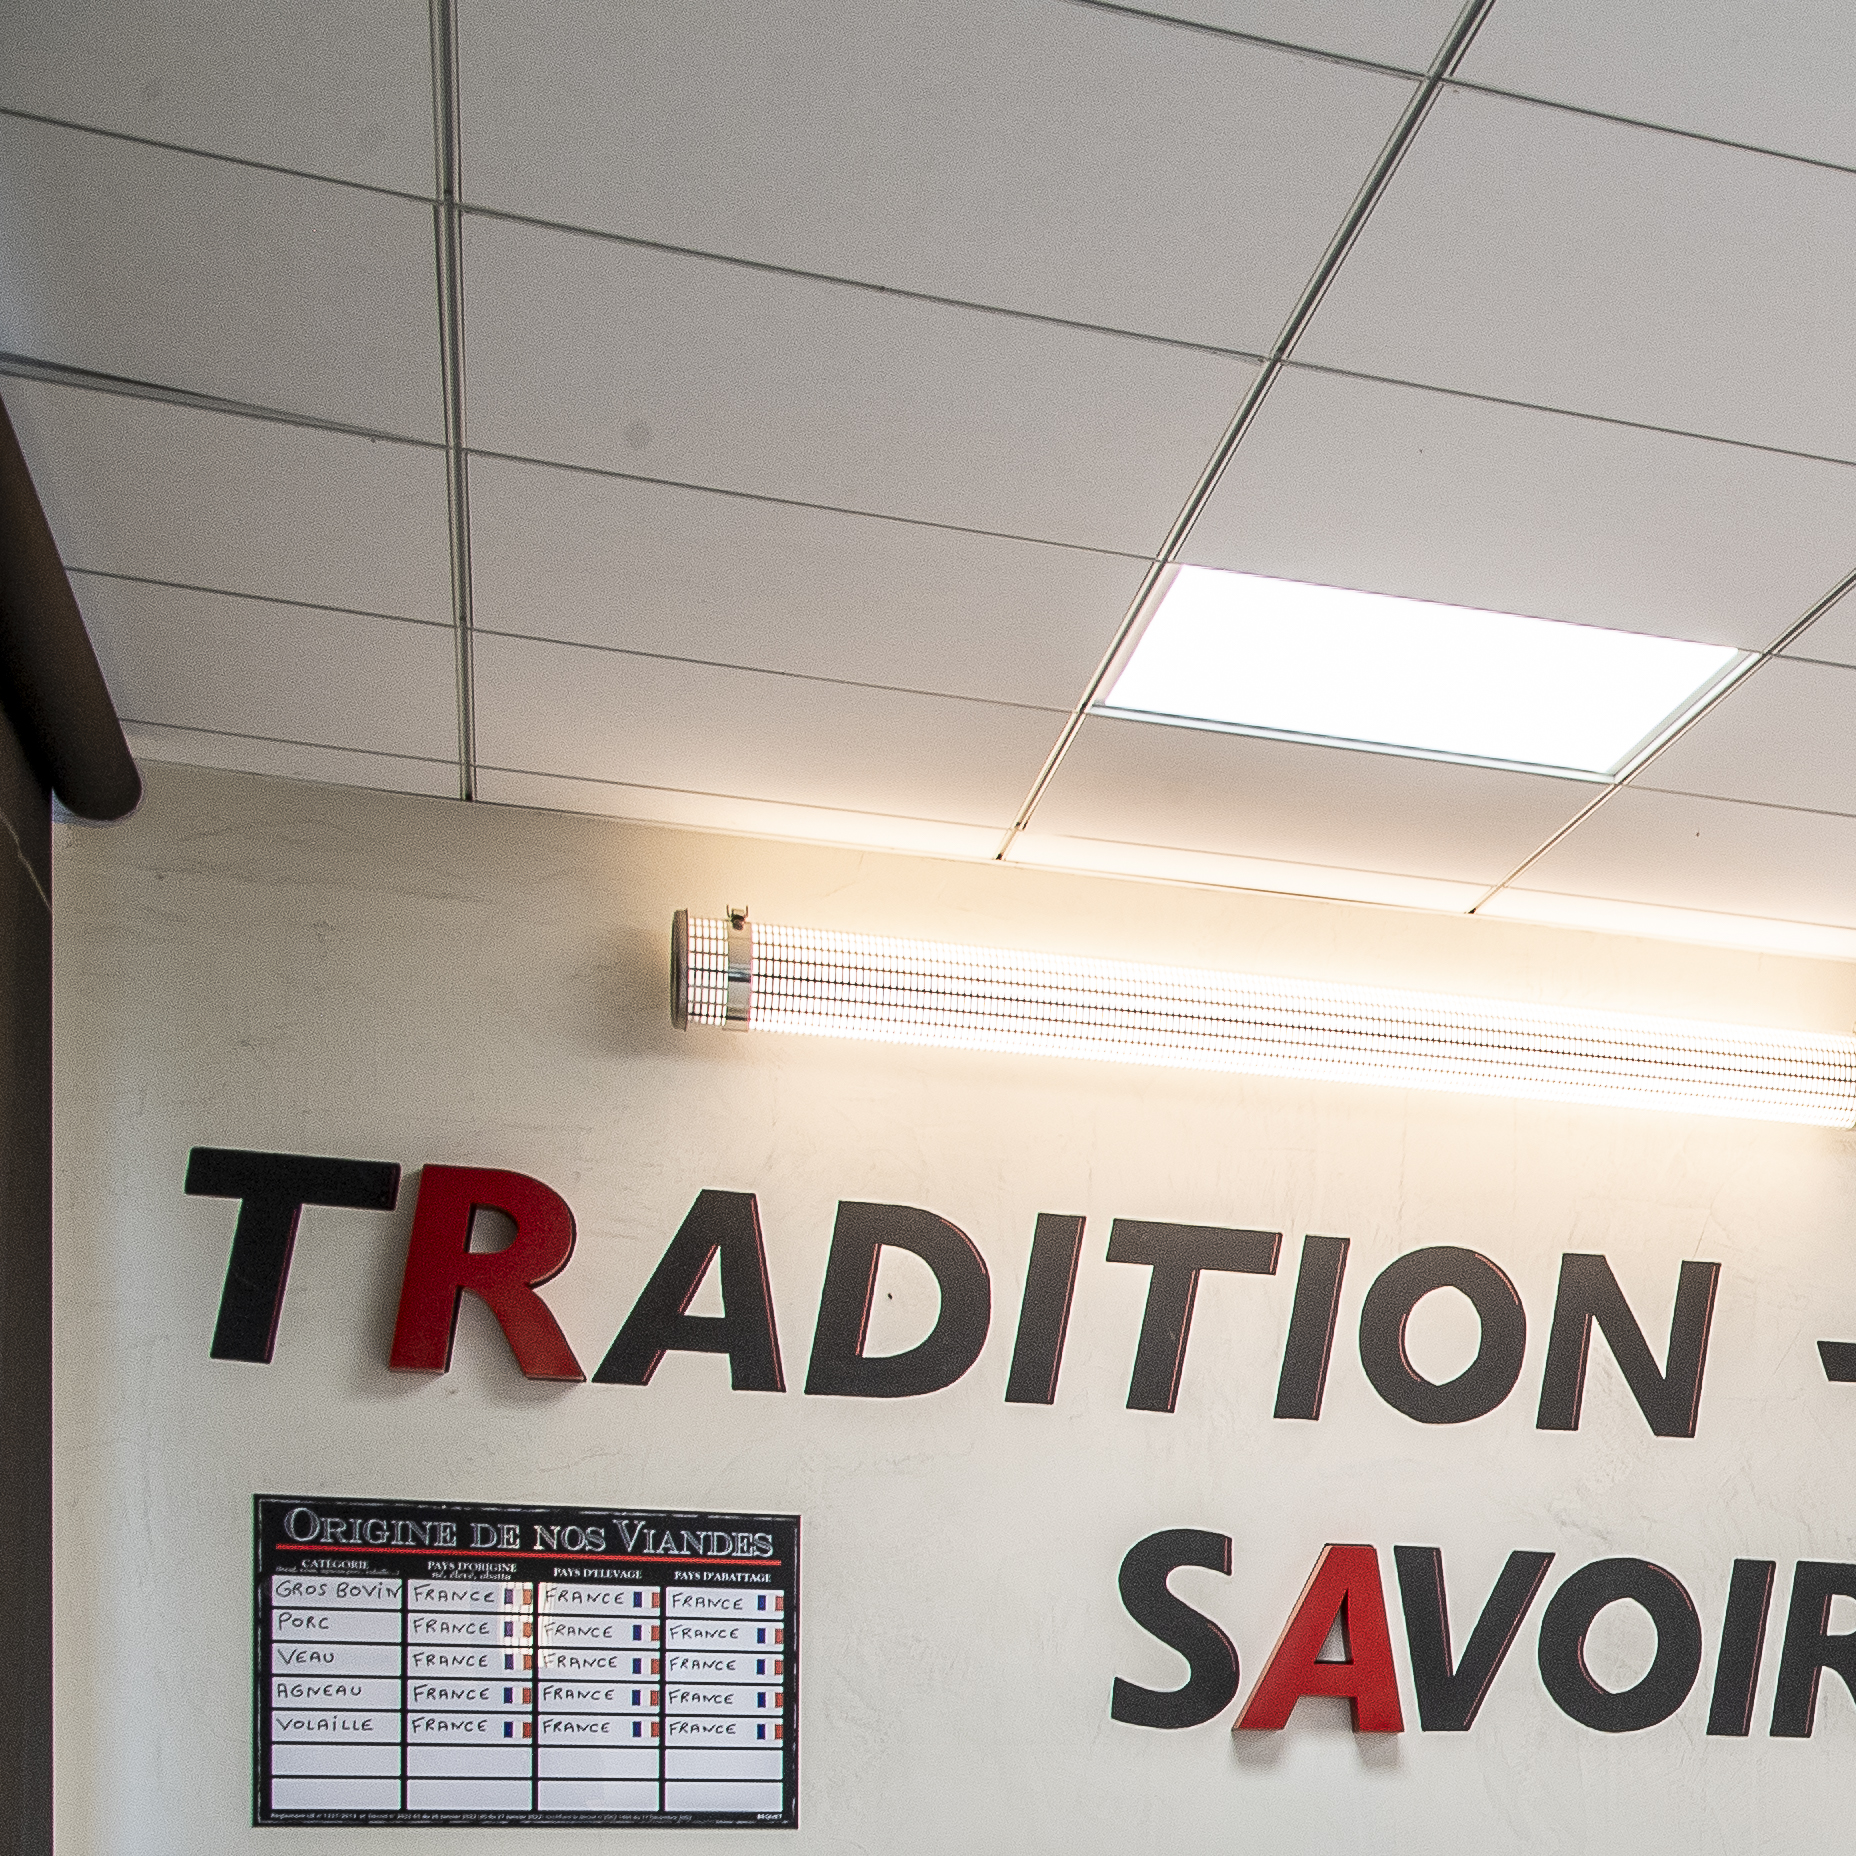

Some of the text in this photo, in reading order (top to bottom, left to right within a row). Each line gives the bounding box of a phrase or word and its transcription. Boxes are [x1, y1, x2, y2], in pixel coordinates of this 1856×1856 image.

[184, 1147, 1722, 1438] TRADITION
[283, 1507, 775, 1558] ORIGINE DE NOS VIANDES
[427, 1560, 455, 1571] PAYS
[275, 1580, 328, 1599] GROS
[413, 1583, 496, 1603] FRANCE
[544, 1586, 625, 1605] FRANCE
[671, 1592, 744, 1610] FRANCE
[277, 1612, 330, 1631] PORC
[413, 1616, 491, 1635] FRANCE
[543, 1621, 614, 1639] FRANCE
[669, 1624, 740, 1640] FRANCE
[277, 1648, 335, 1666] VEAU
[411, 1651, 489, 1671] FRANCE
[542, 1652, 618, 1670] FRANCE
[669, 1655, 737, 1671] FRANCE
[276, 1682, 363, 1699] AGNEAU
[412, 1683, 491, 1703] FRANCE
[542, 1684, 616, 1701] FRANCE
[668, 1688, 735, 1705] FRANCE
[411, 1716, 489, 1734] FRANCE
[542, 1719, 611, 1735] FRANCE
[669, 1720, 737, 1736] FRANCE
